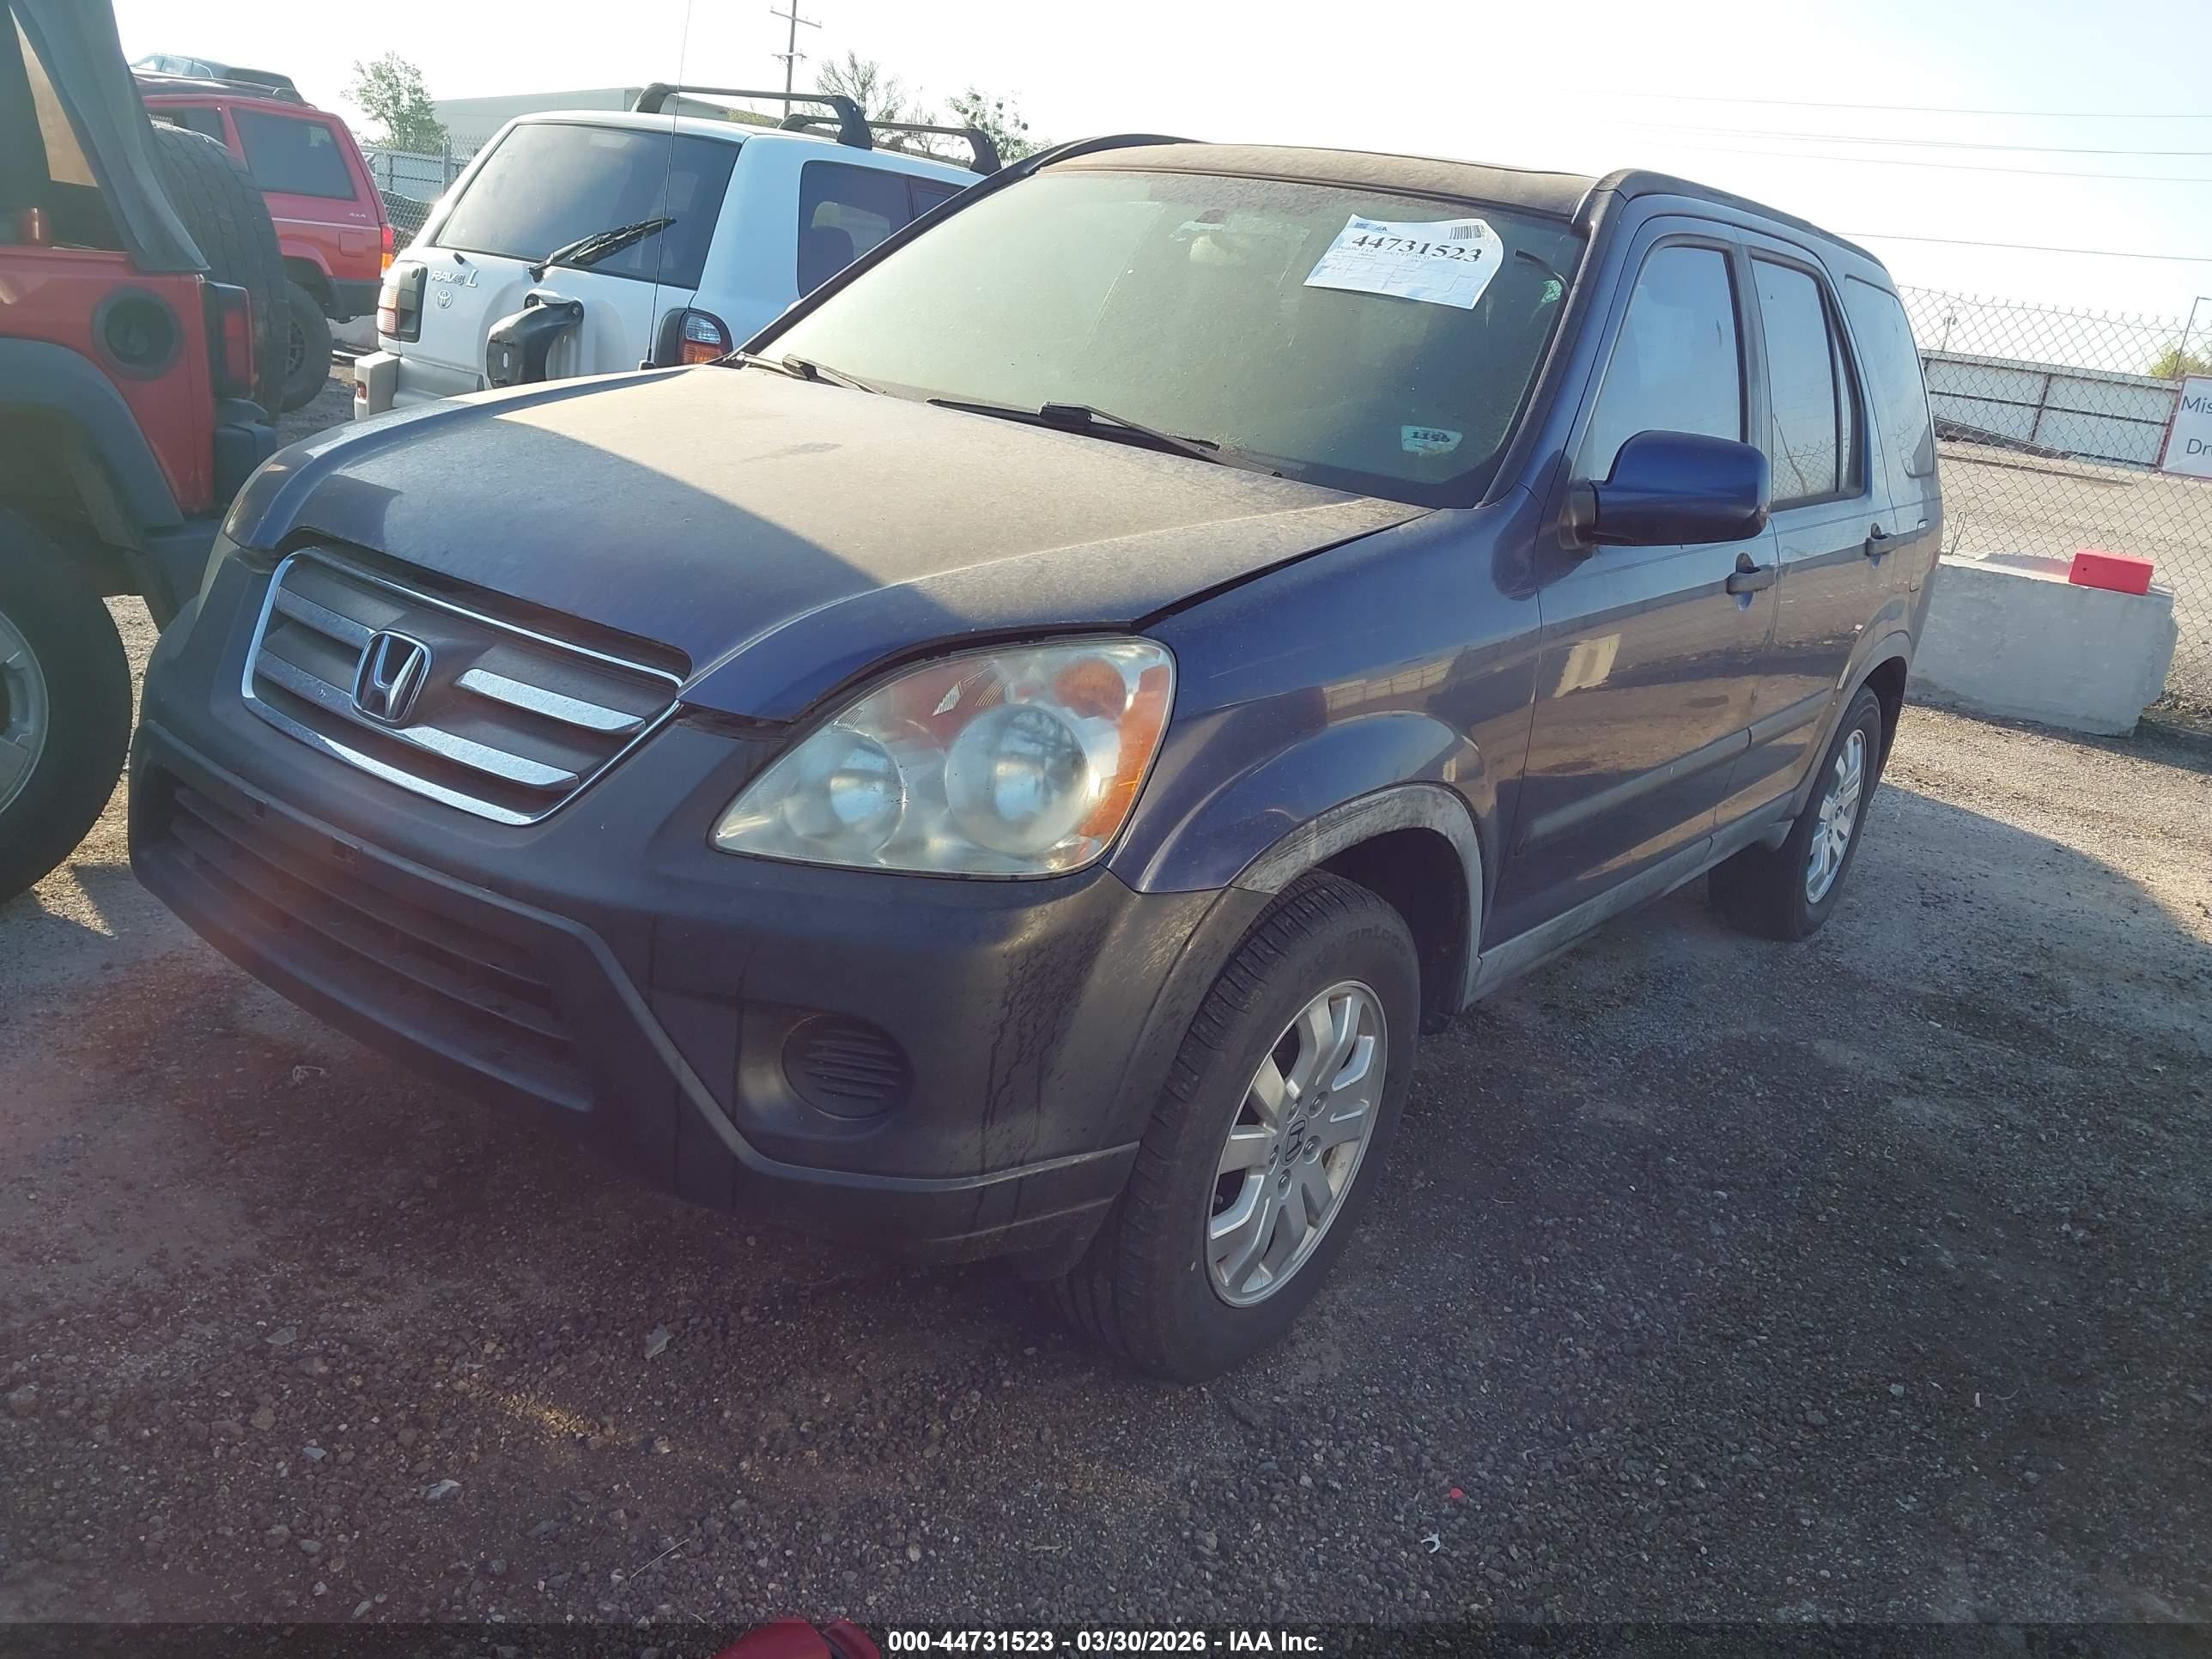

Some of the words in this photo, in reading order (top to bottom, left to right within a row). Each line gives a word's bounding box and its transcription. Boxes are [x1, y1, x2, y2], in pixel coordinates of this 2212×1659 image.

[1352, 234, 1482, 263] 44731523
[430, 270, 466, 286] RAV4
[2186, 438, 2212, 456] Dr
